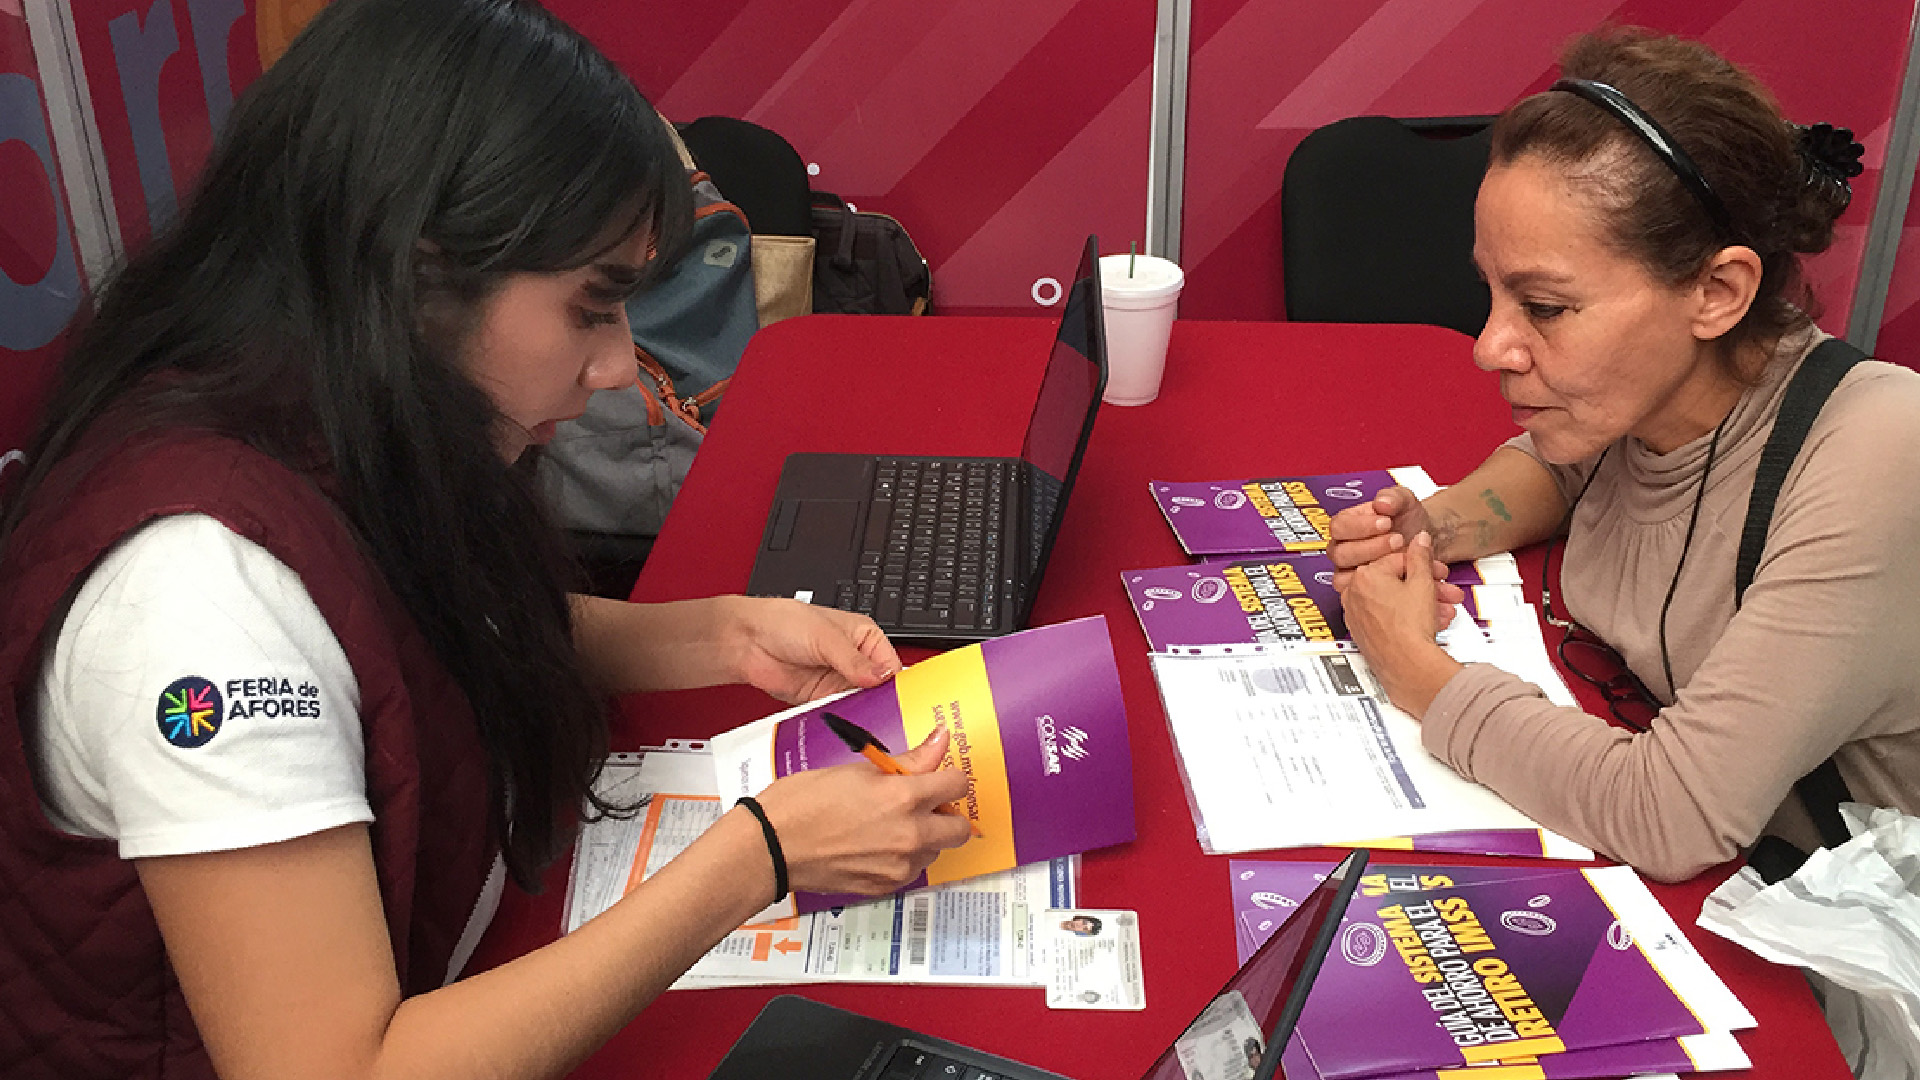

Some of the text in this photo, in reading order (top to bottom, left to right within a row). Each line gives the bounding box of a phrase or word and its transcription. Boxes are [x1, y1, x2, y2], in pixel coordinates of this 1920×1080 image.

[1266, 563, 1307, 595] IMSS
[226, 677, 320, 698] FERIA de
[226, 699, 320, 720] AFORES
[1404, 900, 1438, 919] EL
[1433, 896, 1497, 954] IMSS
[1377, 904, 1444, 983] SISTEMA
[1414, 918, 1461, 957] PARA
[1422, 982, 1462, 1012] DEL
[1438, 959, 1505, 1019] AHORRO
[1473, 957, 1557, 1038] RETIRO
[1436, 1010, 1485, 1046] GUÍA
[1478, 1019, 1520, 1042] DE
